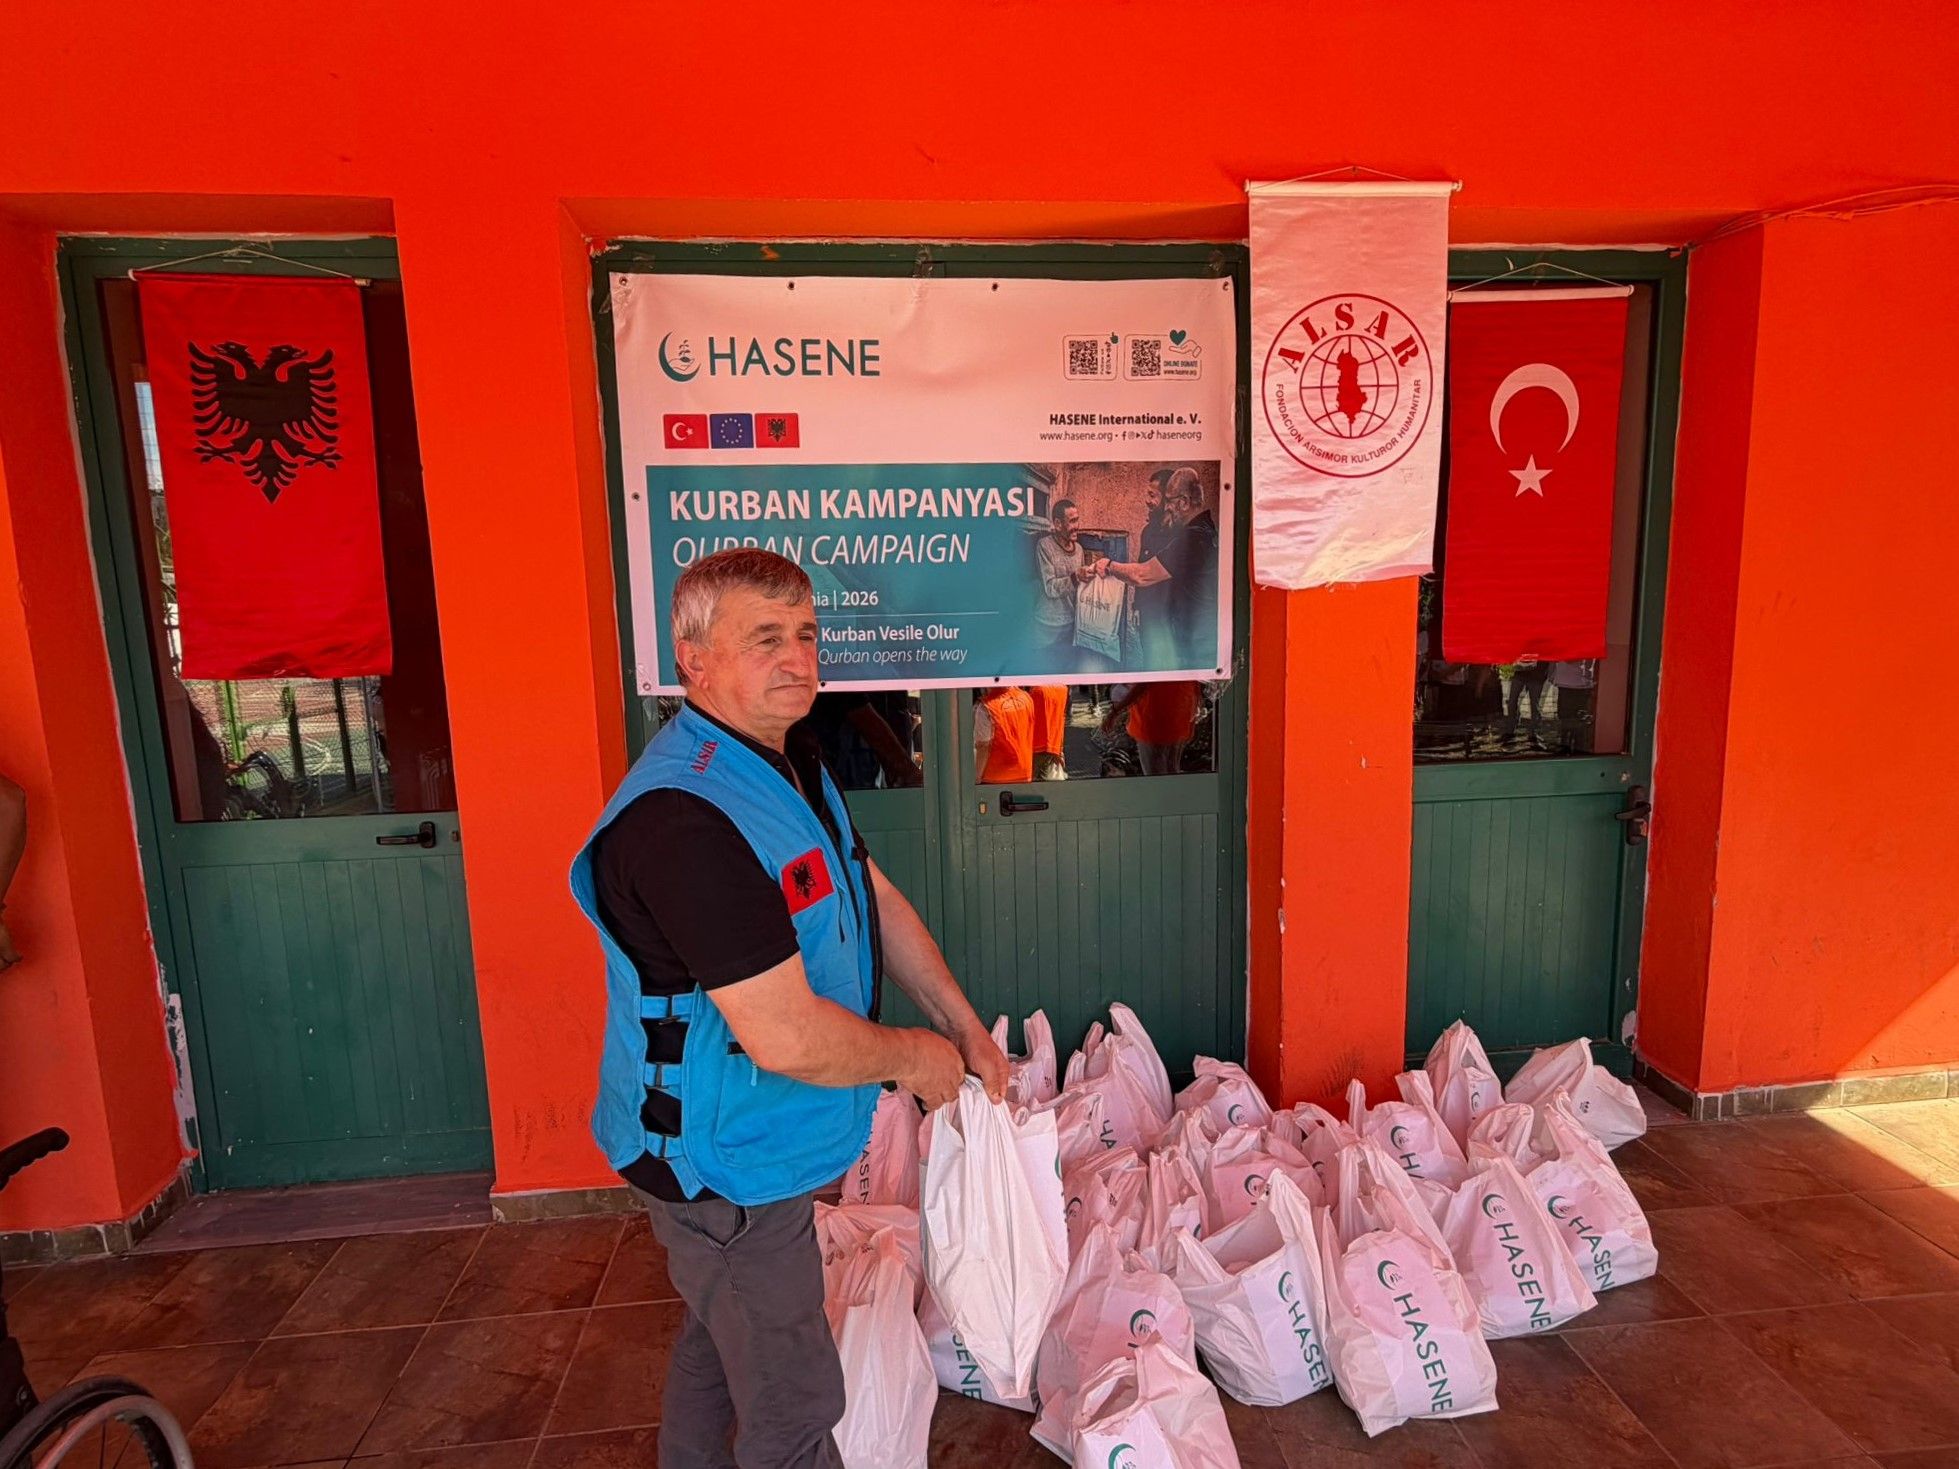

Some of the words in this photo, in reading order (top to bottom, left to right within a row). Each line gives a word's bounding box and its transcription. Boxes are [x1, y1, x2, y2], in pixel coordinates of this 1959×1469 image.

[1277, 303, 1419, 374] ALSAR
[708, 336, 881, 376] HASENE
[1050, 413, 1096, 425] HASENE
[1099, 412, 1174, 425] International
[1176, 415, 1187, 424] e.
[1189, 413, 1202, 424] V.
[1275, 383, 1304, 443] FONDACION
[1302, 441, 1348, 464] ARSIMOR
[1351, 437, 1399, 464] KULTUROR
[1397, 379, 1422, 439] HUMANITAR
[1039, 431, 1113, 442] www.hasene.org
[1156, 430, 1202, 441] haseneorg
[669, 489, 811, 521] KURBAN
[819, 487, 1035, 519] KAMPANYASI
[811, 533, 971, 566] CAMPAIGN
[841, 590, 879, 606] 2026
[821, 625, 876, 642] Kurban
[878, 625, 923, 641] Vesile
[926, 624, 960, 640] Olur
[817, 647, 870, 665] Qurban
[872, 649, 912, 666] opens
[916, 646, 939, 662] the
[940, 648, 968, 665] way
[1568, 1216, 1615, 1289] HASEN
[1493, 1222, 1552, 1328] HASENE
[1393, 1292, 1453, 1413] HASENE
